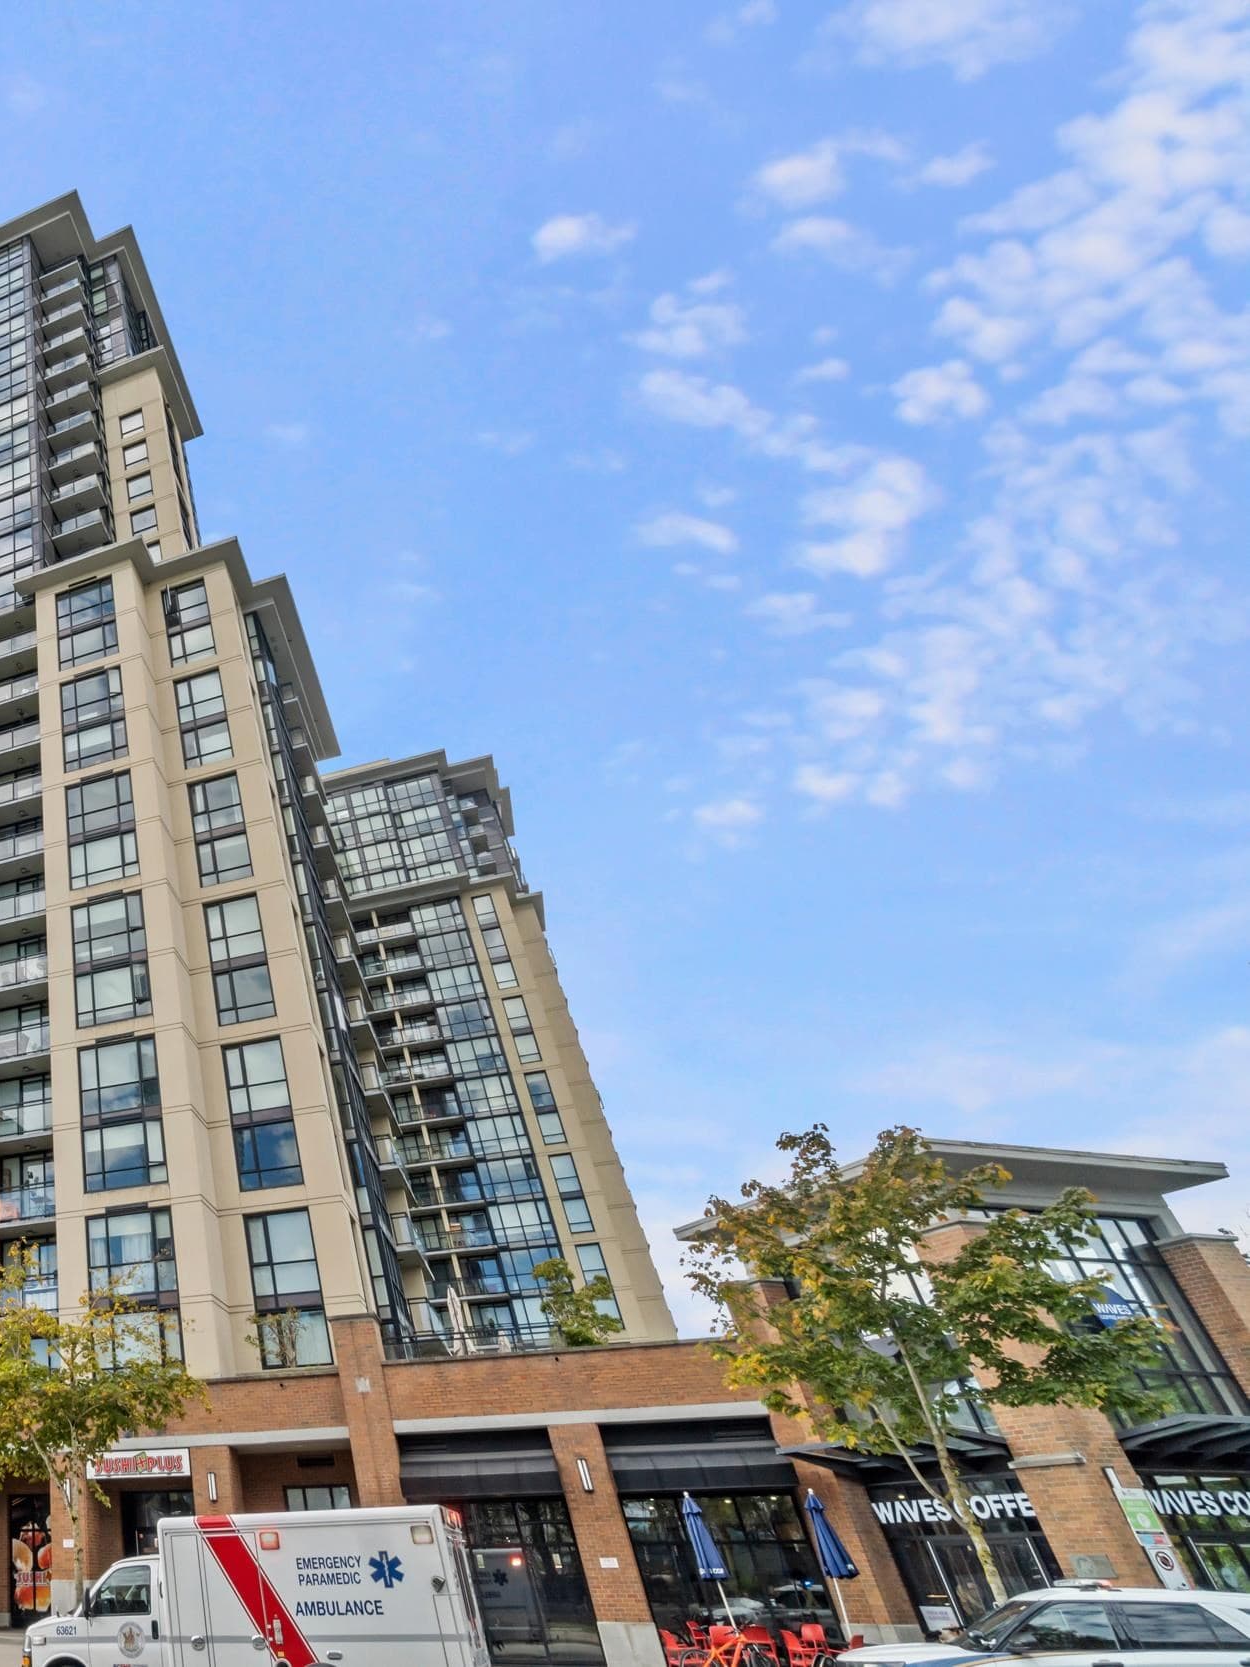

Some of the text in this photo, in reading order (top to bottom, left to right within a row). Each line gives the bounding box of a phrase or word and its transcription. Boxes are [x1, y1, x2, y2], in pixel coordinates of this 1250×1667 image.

[1092, 1303, 1133, 1315] WAVES
[94, 1454, 184, 1475] SUSHI PLUS
[871, 1498, 952, 1525] WAVES
[1144, 1489, 1223, 1517] WAVES
[1217, 1490, 1250, 1517] CO
[295, 1555, 362, 1571] EMERGENCY
[298, 1571, 362, 1586] PARAMEDIC
[295, 1599, 385, 1617] AMBULANCE
[55, 1625, 77, 1636] 63621
